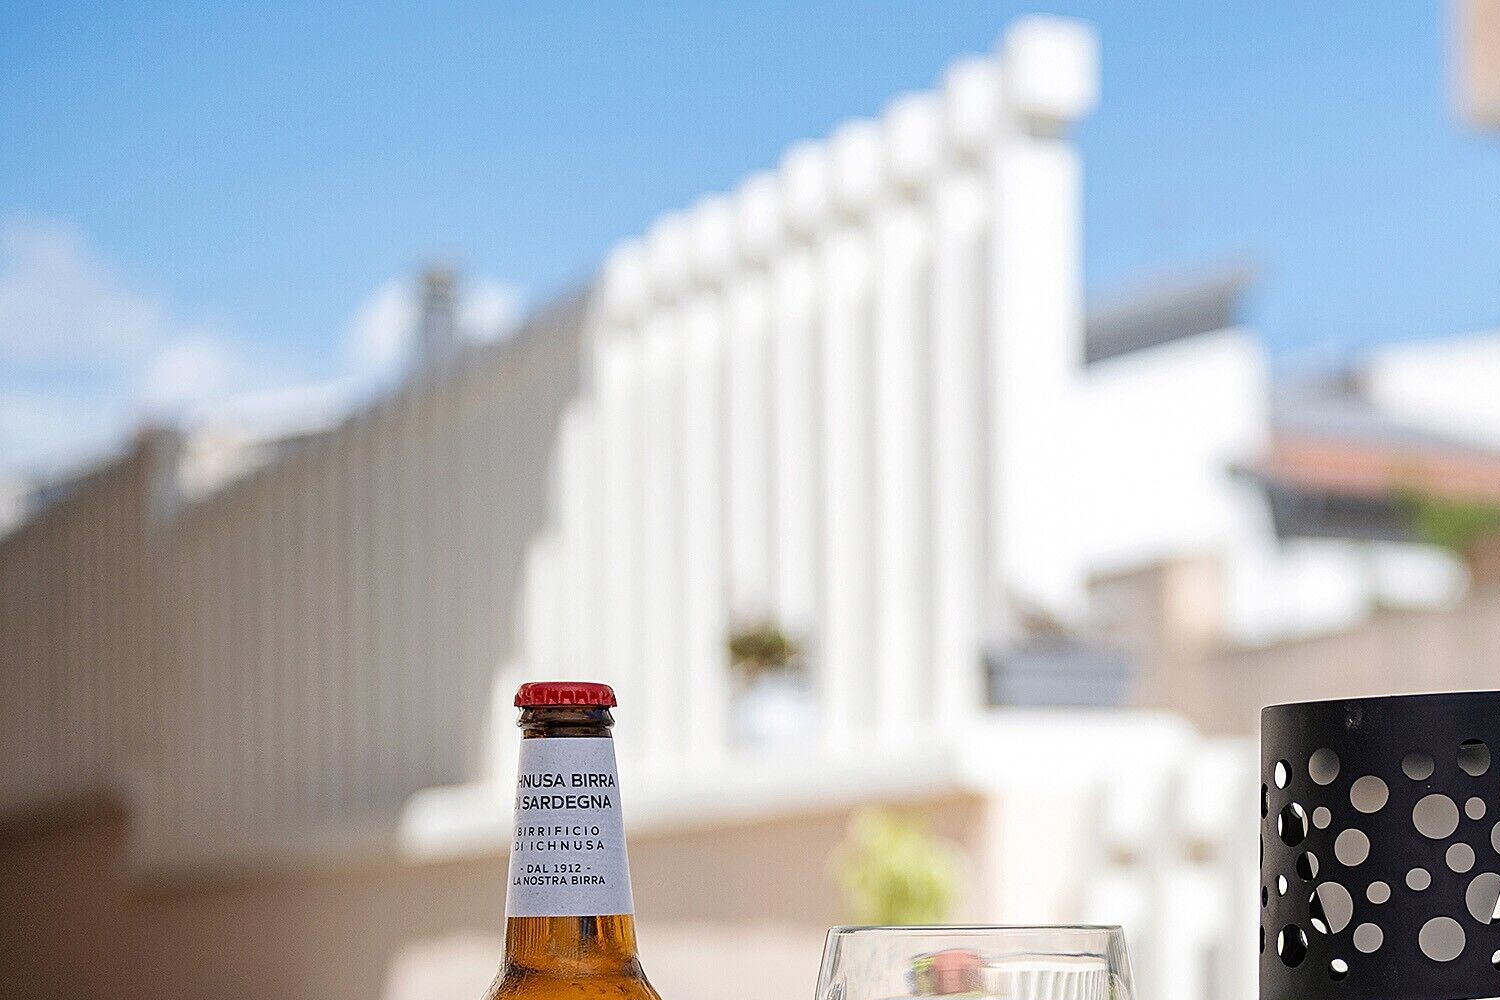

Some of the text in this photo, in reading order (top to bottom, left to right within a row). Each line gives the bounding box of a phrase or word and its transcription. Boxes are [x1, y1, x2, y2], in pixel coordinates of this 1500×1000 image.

[571, 773, 616, 788] BIRRA
[522, 794, 612, 810] SARDEGNA
[517, 826, 600, 837] BIRRIFICIO
[530, 840, 605, 851] ICHNUSA
[527, 864, 549, 874] DAL
[554, 863, 582, 873] 1912
[523, 876, 568, 886] NOSTRA
[571, 875, 606, 885] BIRRA
